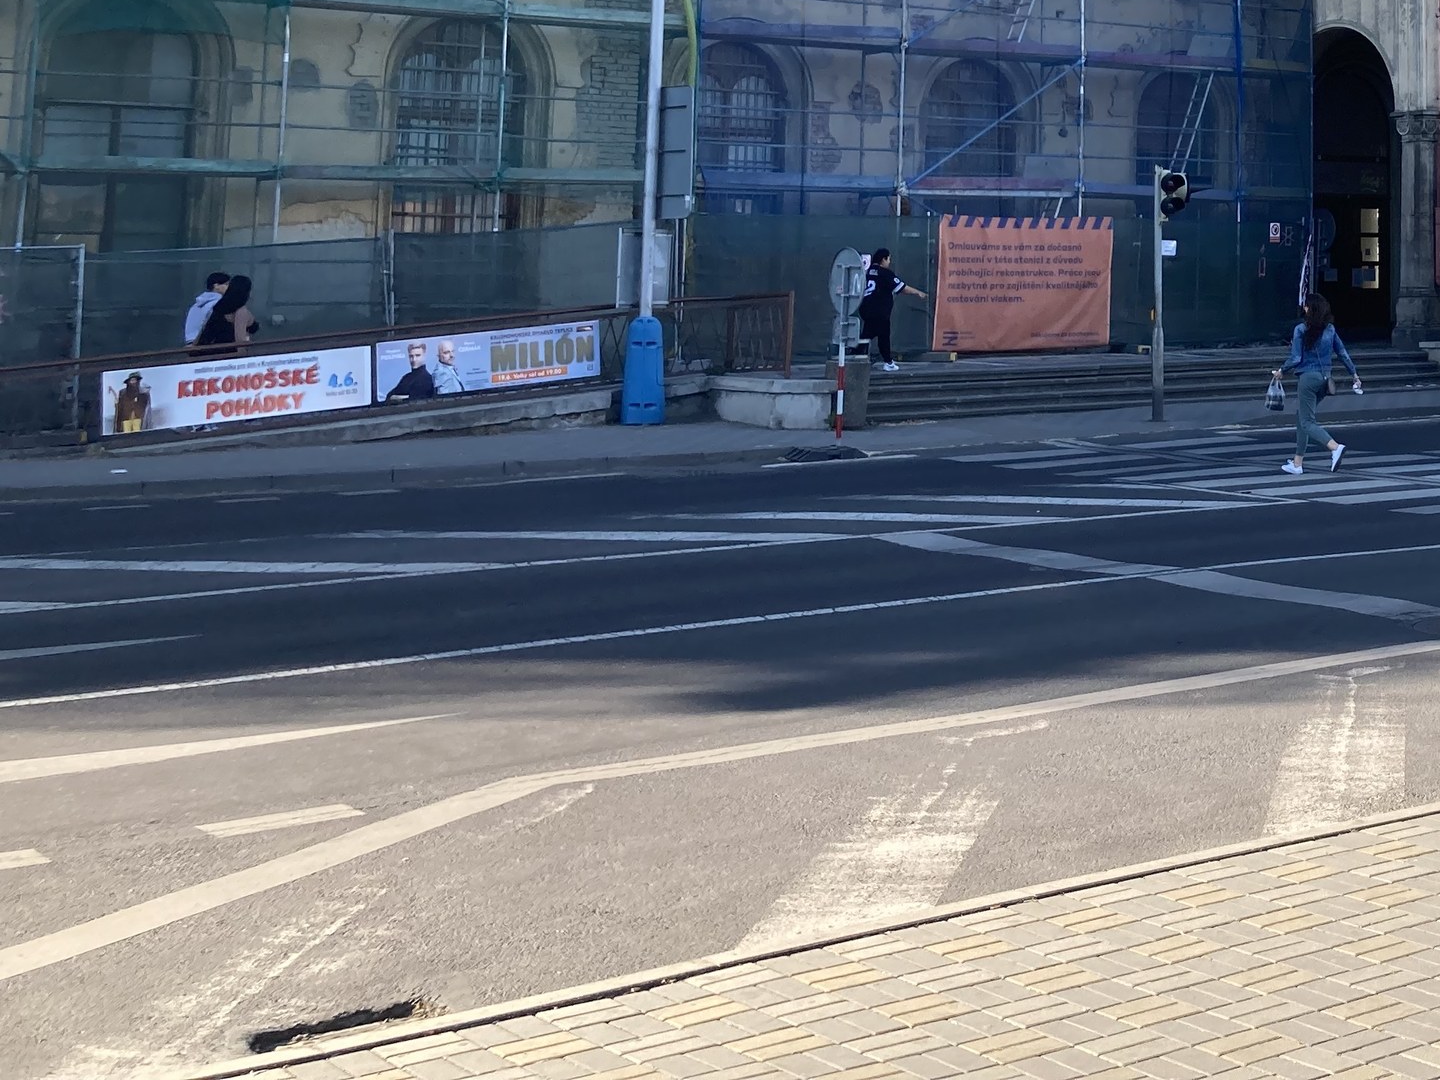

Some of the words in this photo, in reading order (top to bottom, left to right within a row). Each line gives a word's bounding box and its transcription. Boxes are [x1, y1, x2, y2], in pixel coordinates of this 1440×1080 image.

[1014, 242, 1032, 251] vám
[990, 283, 1005, 291] pro
[490, 333, 594, 373] MILIÓN
[177, 363, 320, 399] KRKONOŠSKÉ
[206, 392, 305, 419] POHÁDKY
